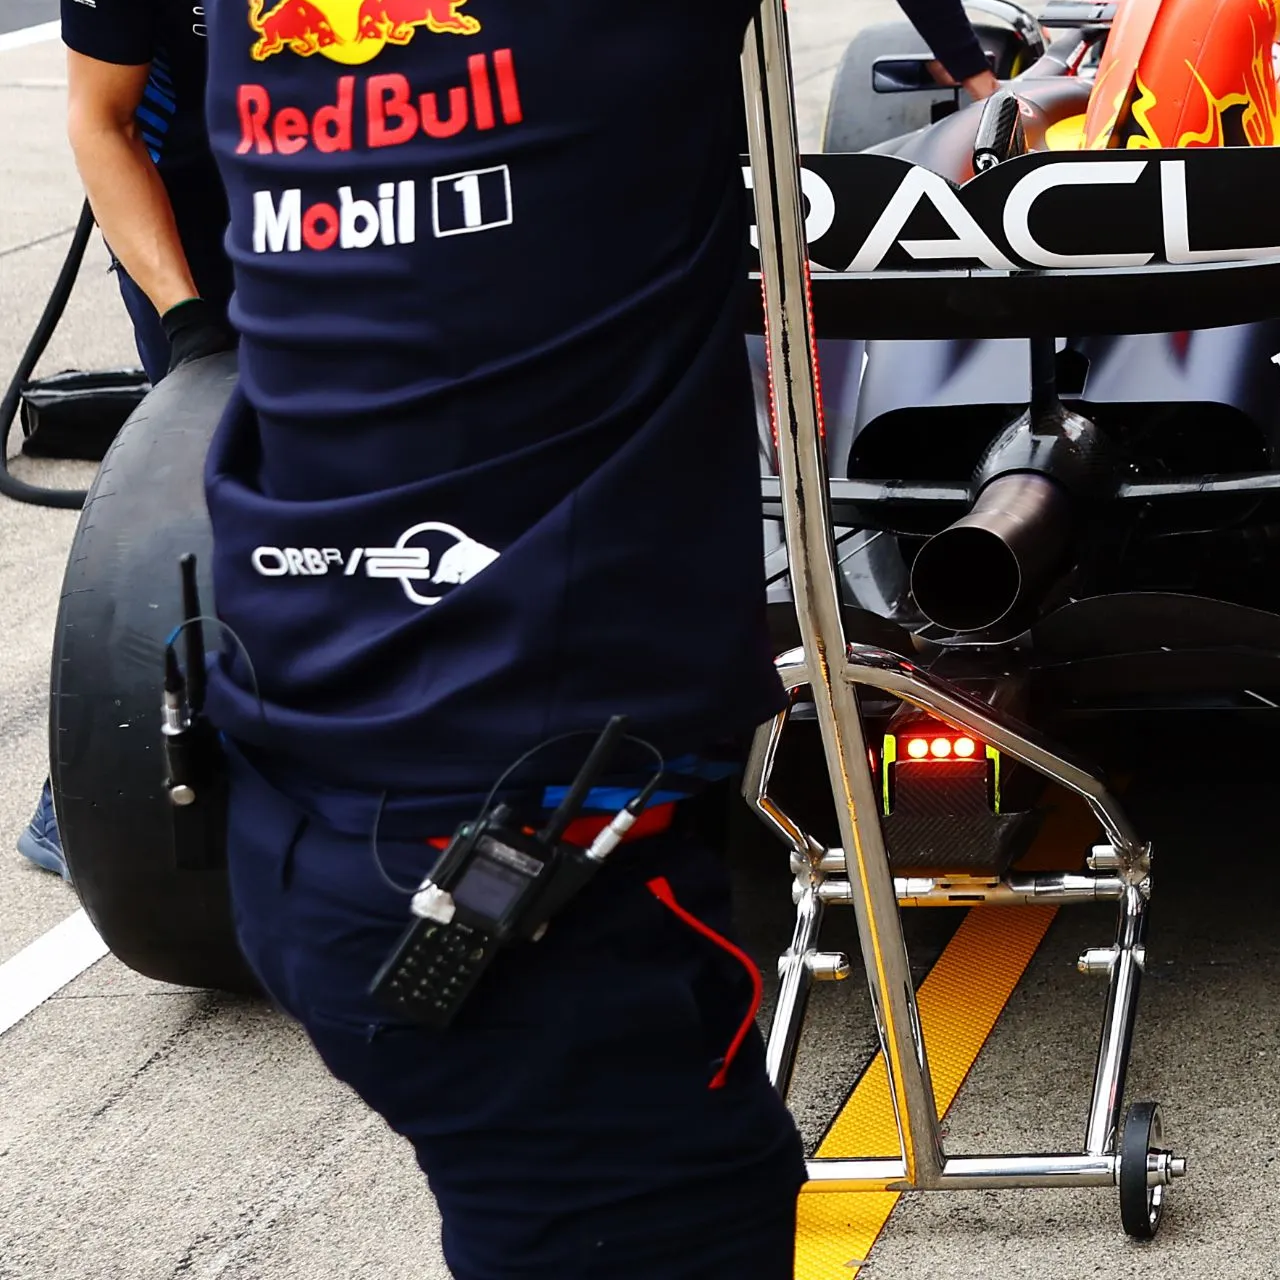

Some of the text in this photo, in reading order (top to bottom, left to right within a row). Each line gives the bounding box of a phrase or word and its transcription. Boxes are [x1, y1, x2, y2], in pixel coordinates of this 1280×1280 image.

[235, 47, 524, 155] Red Bull
[252, 173, 483, 254] Mobil 1
